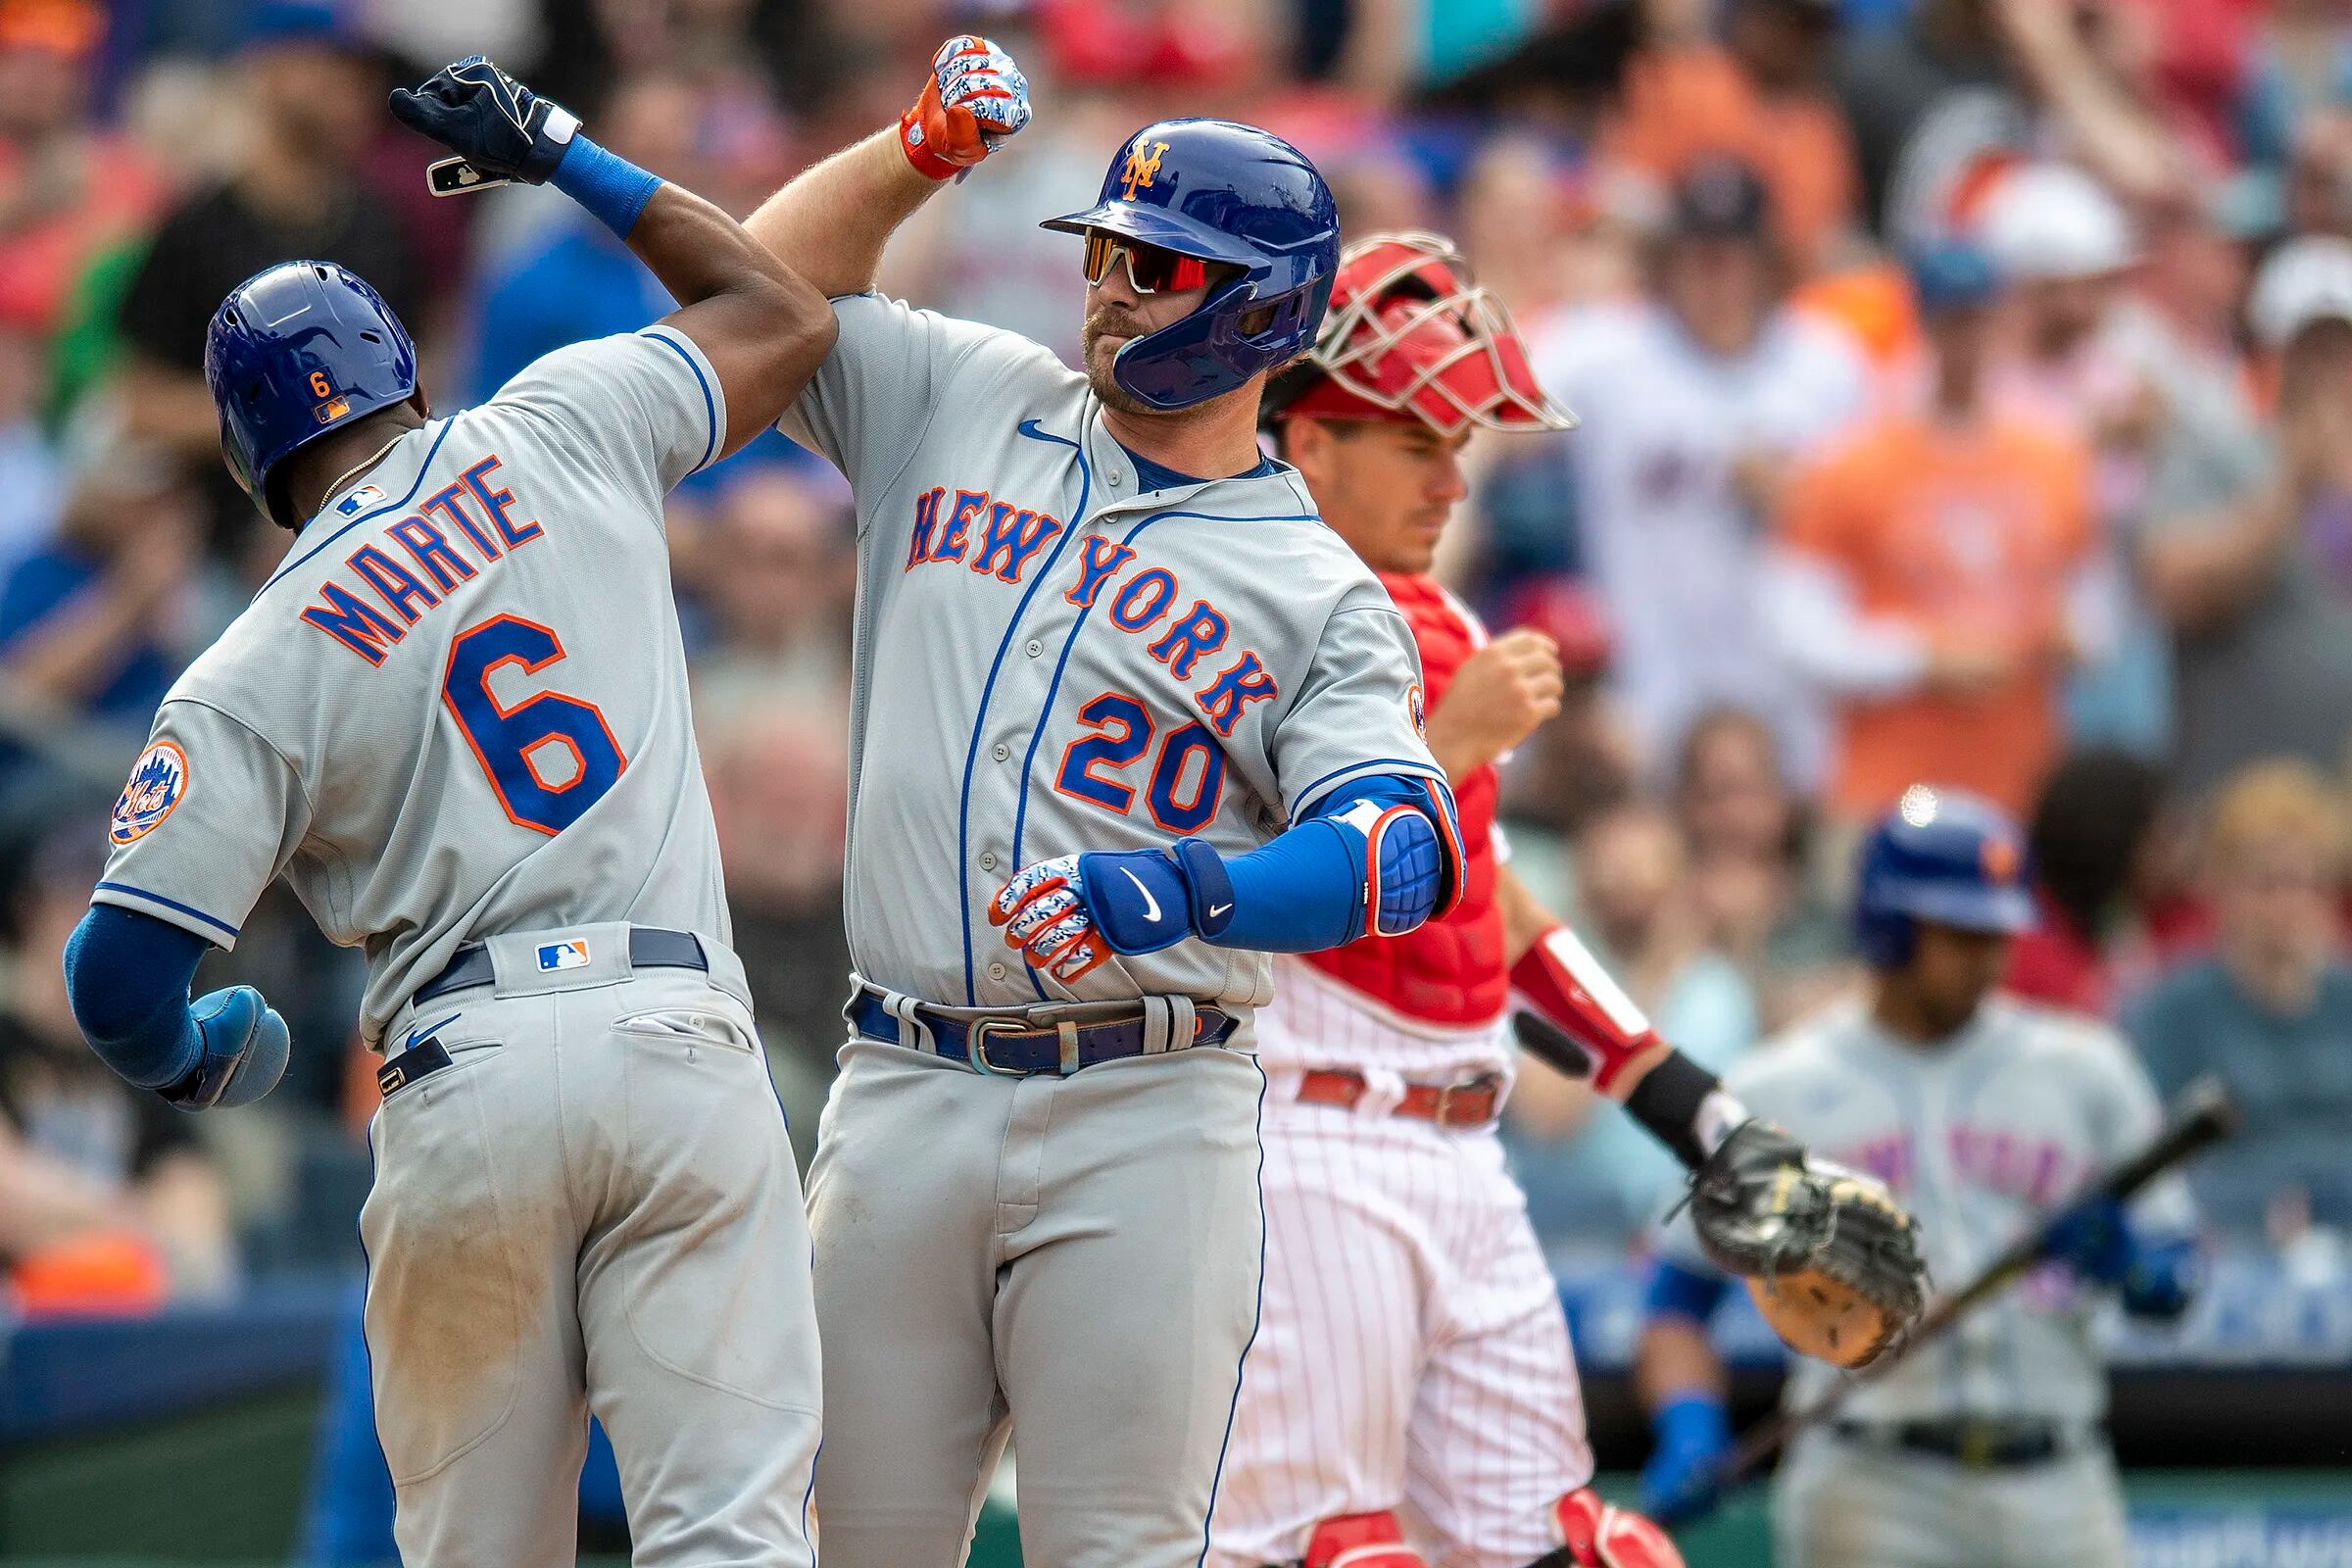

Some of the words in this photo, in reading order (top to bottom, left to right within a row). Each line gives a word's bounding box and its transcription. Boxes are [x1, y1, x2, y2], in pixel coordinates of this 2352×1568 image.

[310, 371, 330, 397] 6
[299, 454, 544, 668] MARTE
[905, 486, 1062, 584] NEW
[1064, 535, 1278, 738] YORK
[117, 780, 170, 821] Mets
[441, 612, 627, 837] 6
[1054, 691, 1227, 835] 20
